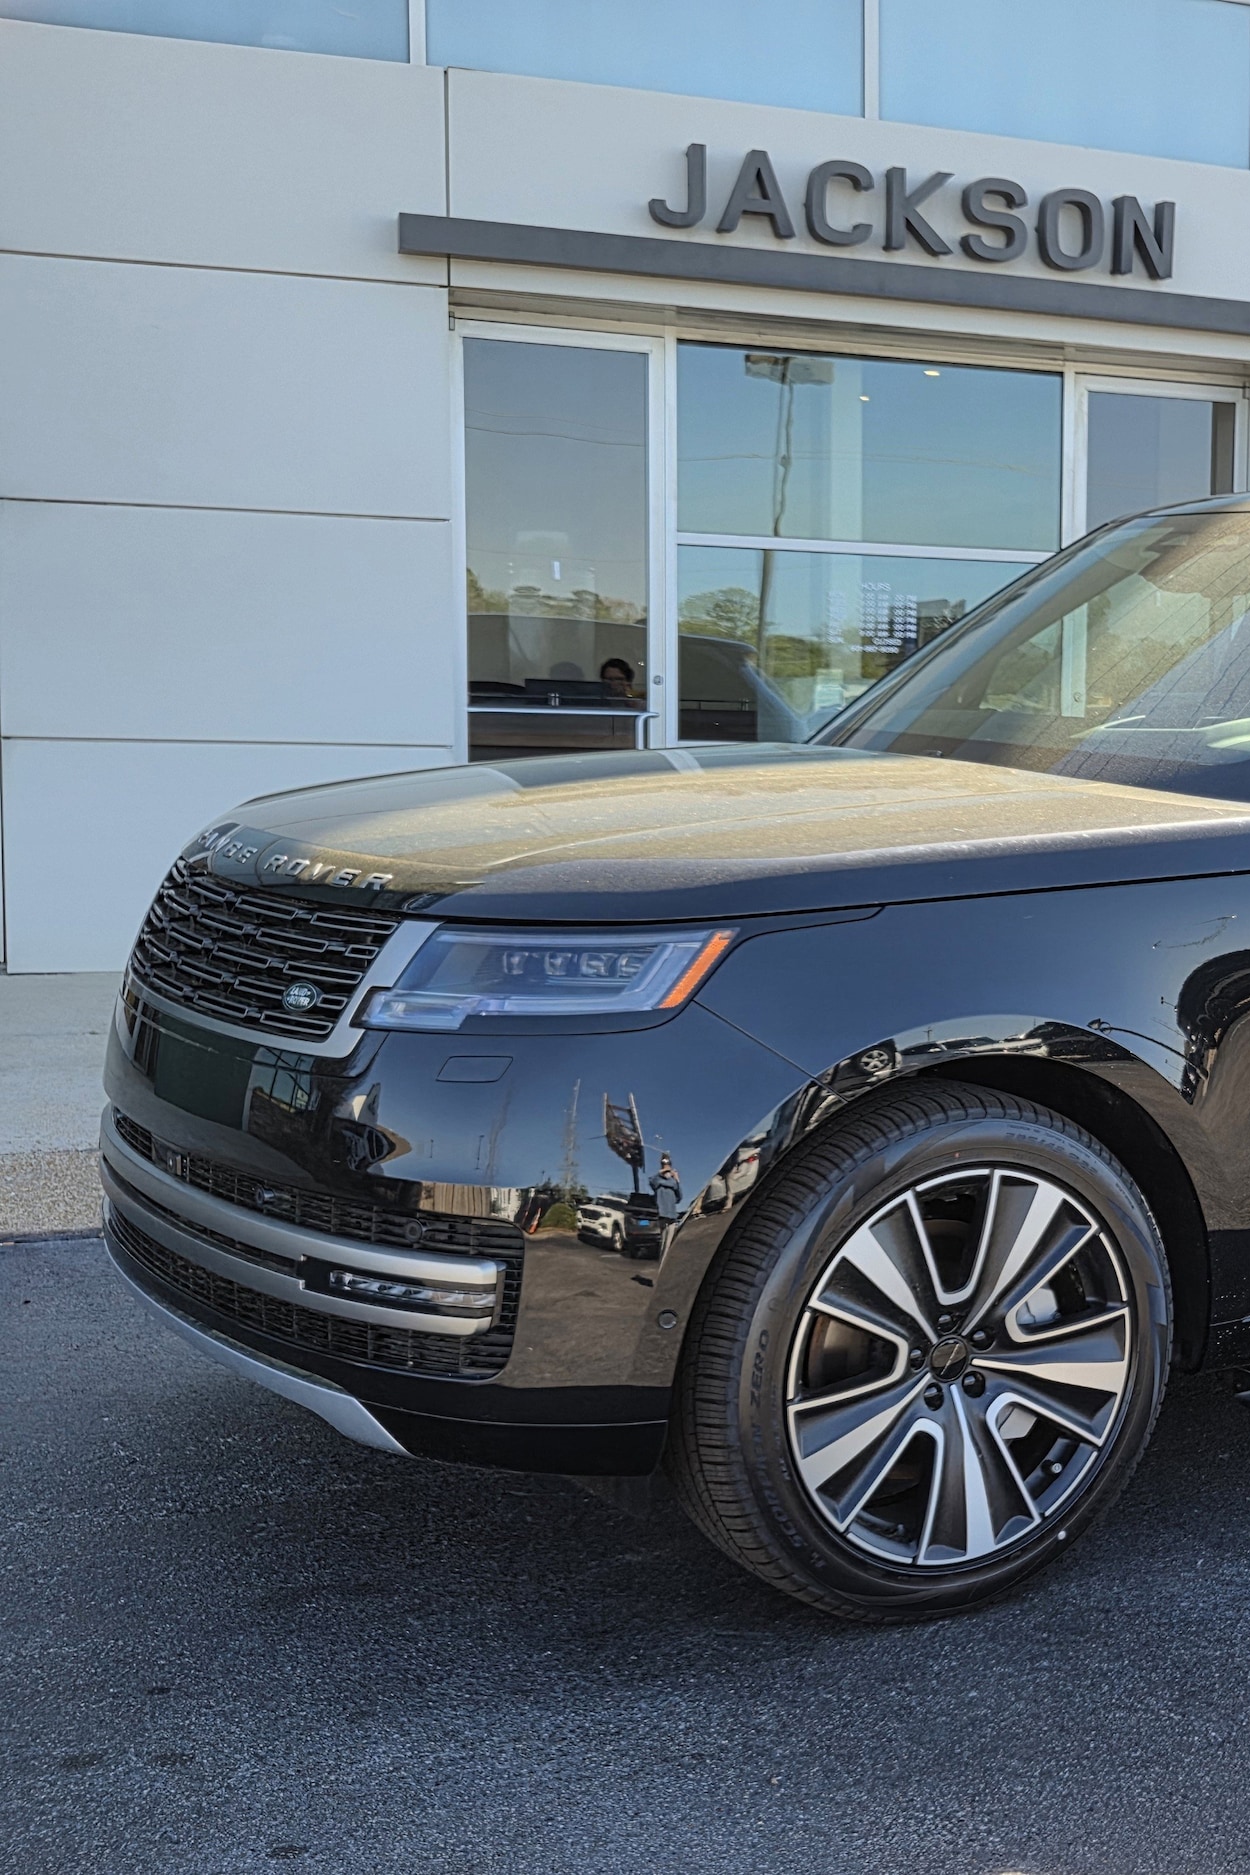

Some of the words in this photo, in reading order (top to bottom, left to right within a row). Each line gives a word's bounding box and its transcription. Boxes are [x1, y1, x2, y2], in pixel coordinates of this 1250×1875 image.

[648, 143, 1176, 280] JACKSON
[263, 855, 393, 891] ROVER
[750, 1329, 769, 1408] ZERO
